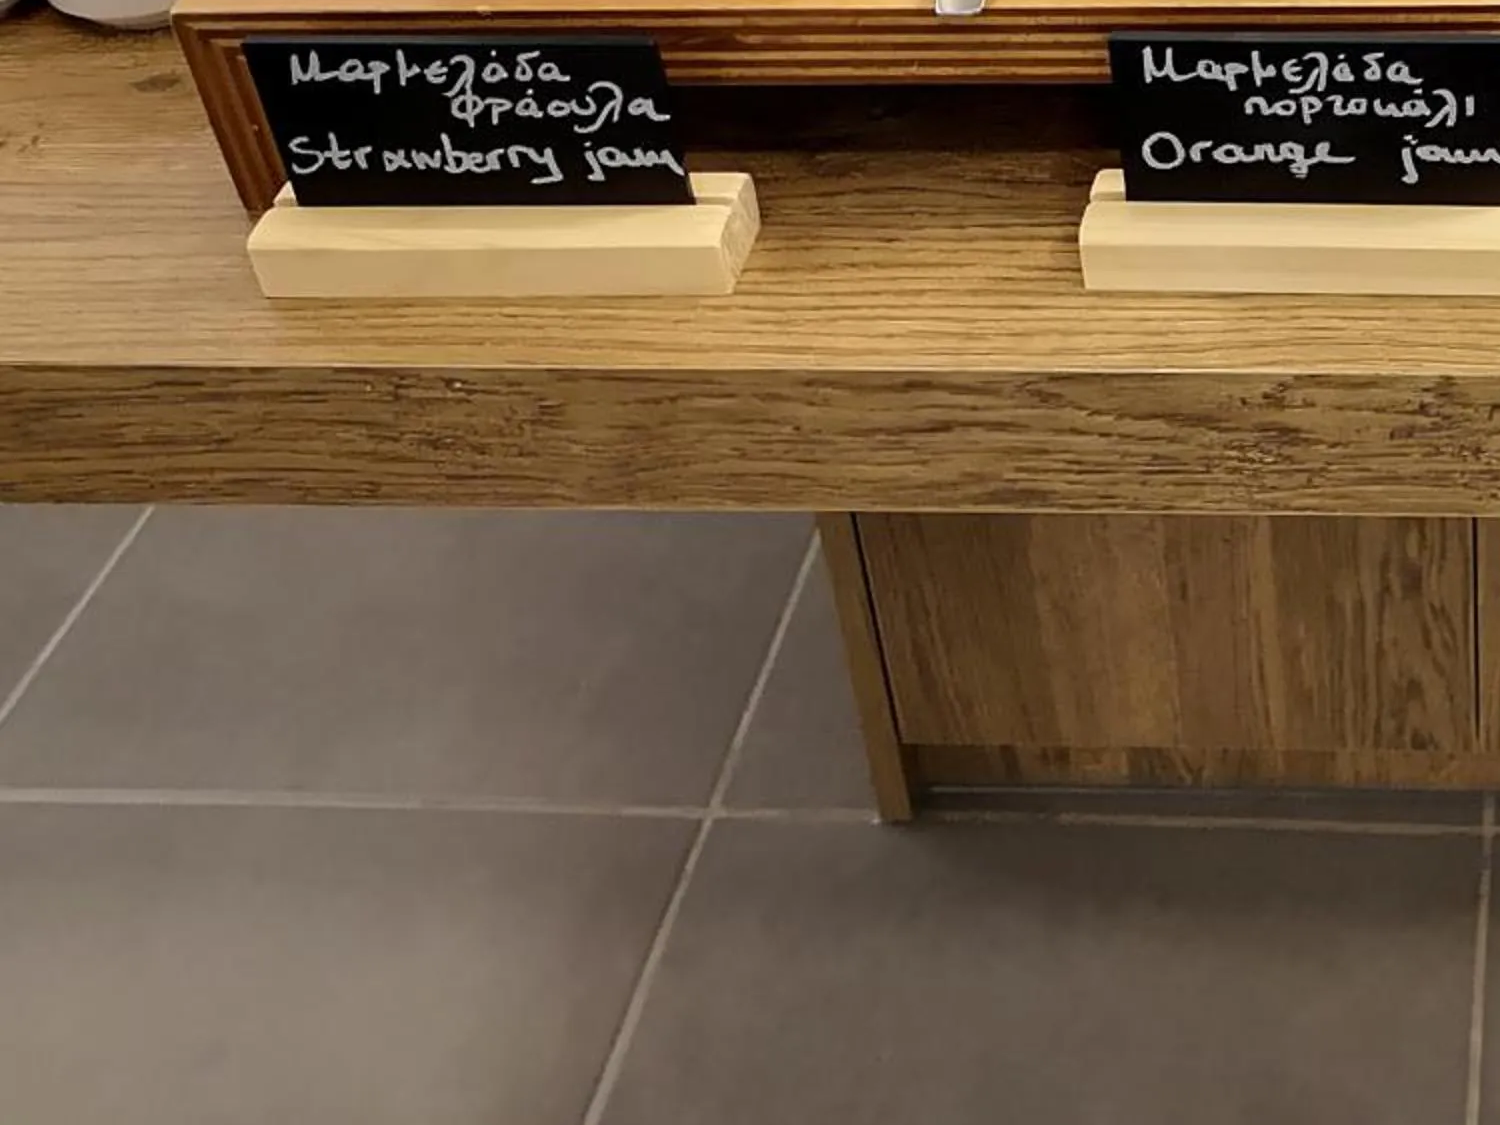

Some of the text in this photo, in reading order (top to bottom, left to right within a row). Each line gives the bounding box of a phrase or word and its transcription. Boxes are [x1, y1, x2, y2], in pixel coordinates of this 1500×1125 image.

[289, 49, 571, 97] Μαρμελάδα
[1141, 45, 1424, 93] Μαρμελάδα
[451, 80, 671, 133] φράουλα
[1243, 87, 1476, 128] πορτοκάλι
[288, 132, 685, 185] Strawberry jam
[1141, 131, 1357, 179] Orange
